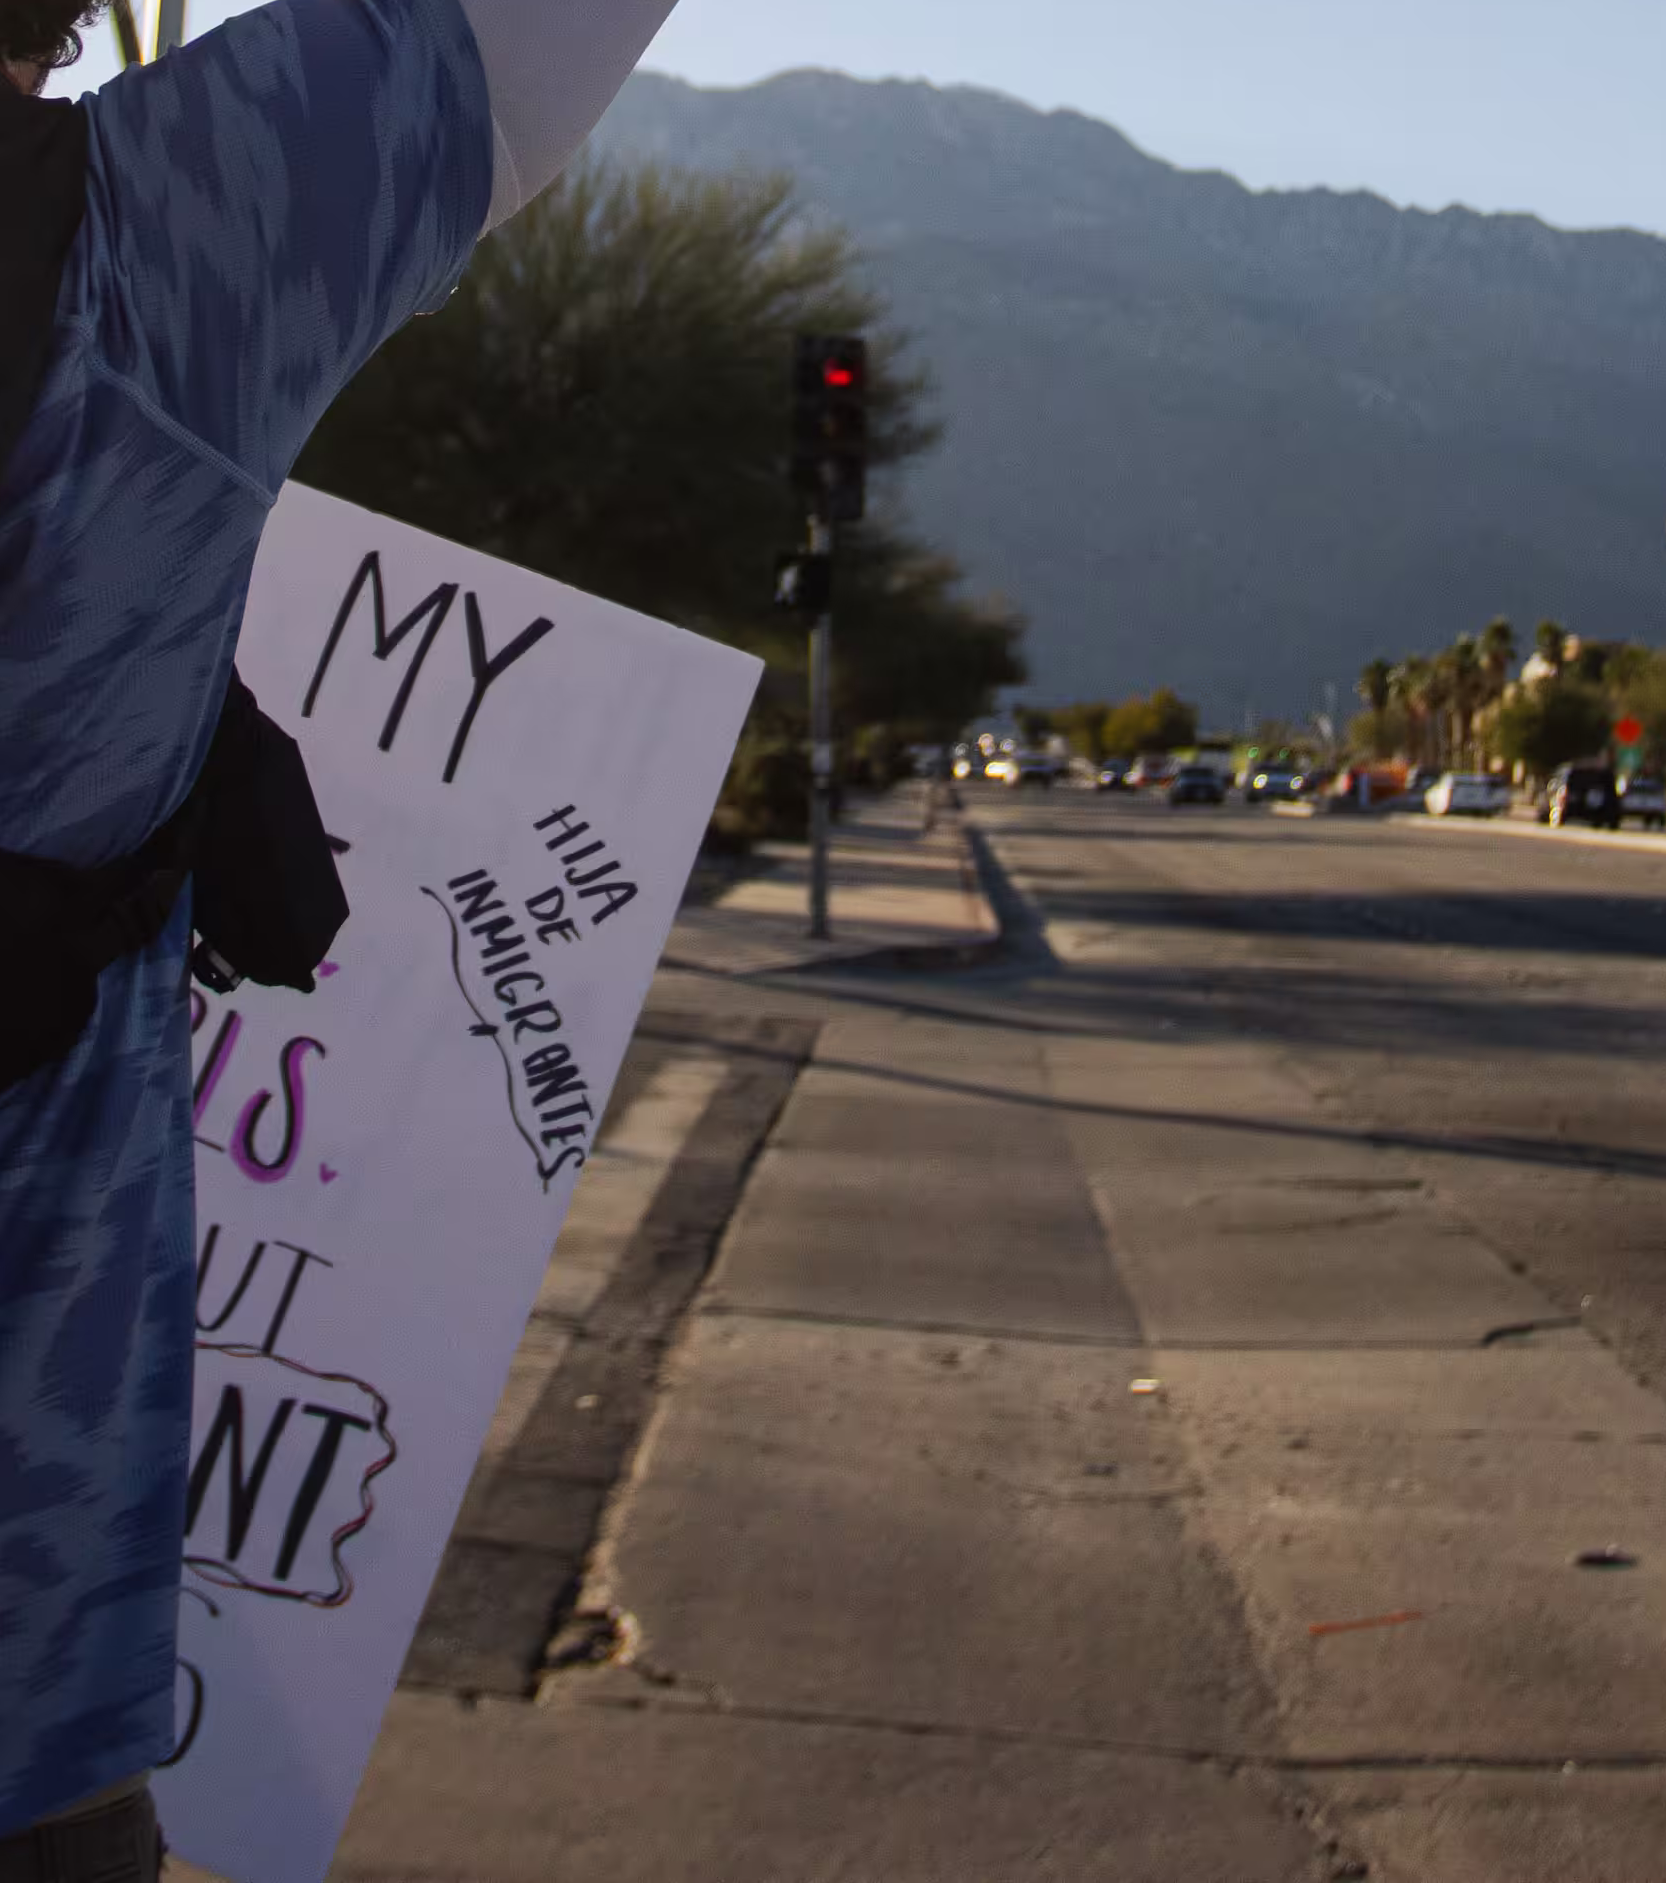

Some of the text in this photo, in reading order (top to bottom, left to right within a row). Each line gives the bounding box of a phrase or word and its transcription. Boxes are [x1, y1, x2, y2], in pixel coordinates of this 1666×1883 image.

[302, 551, 554, 784] MY
[524, 886, 582, 946] DE
[533, 804, 638, 925] HIJA
[447, 869, 593, 1182] INMIGRANTES
[195, 1224, 332, 1355] UT
[185, 1384, 371, 1580] NT
